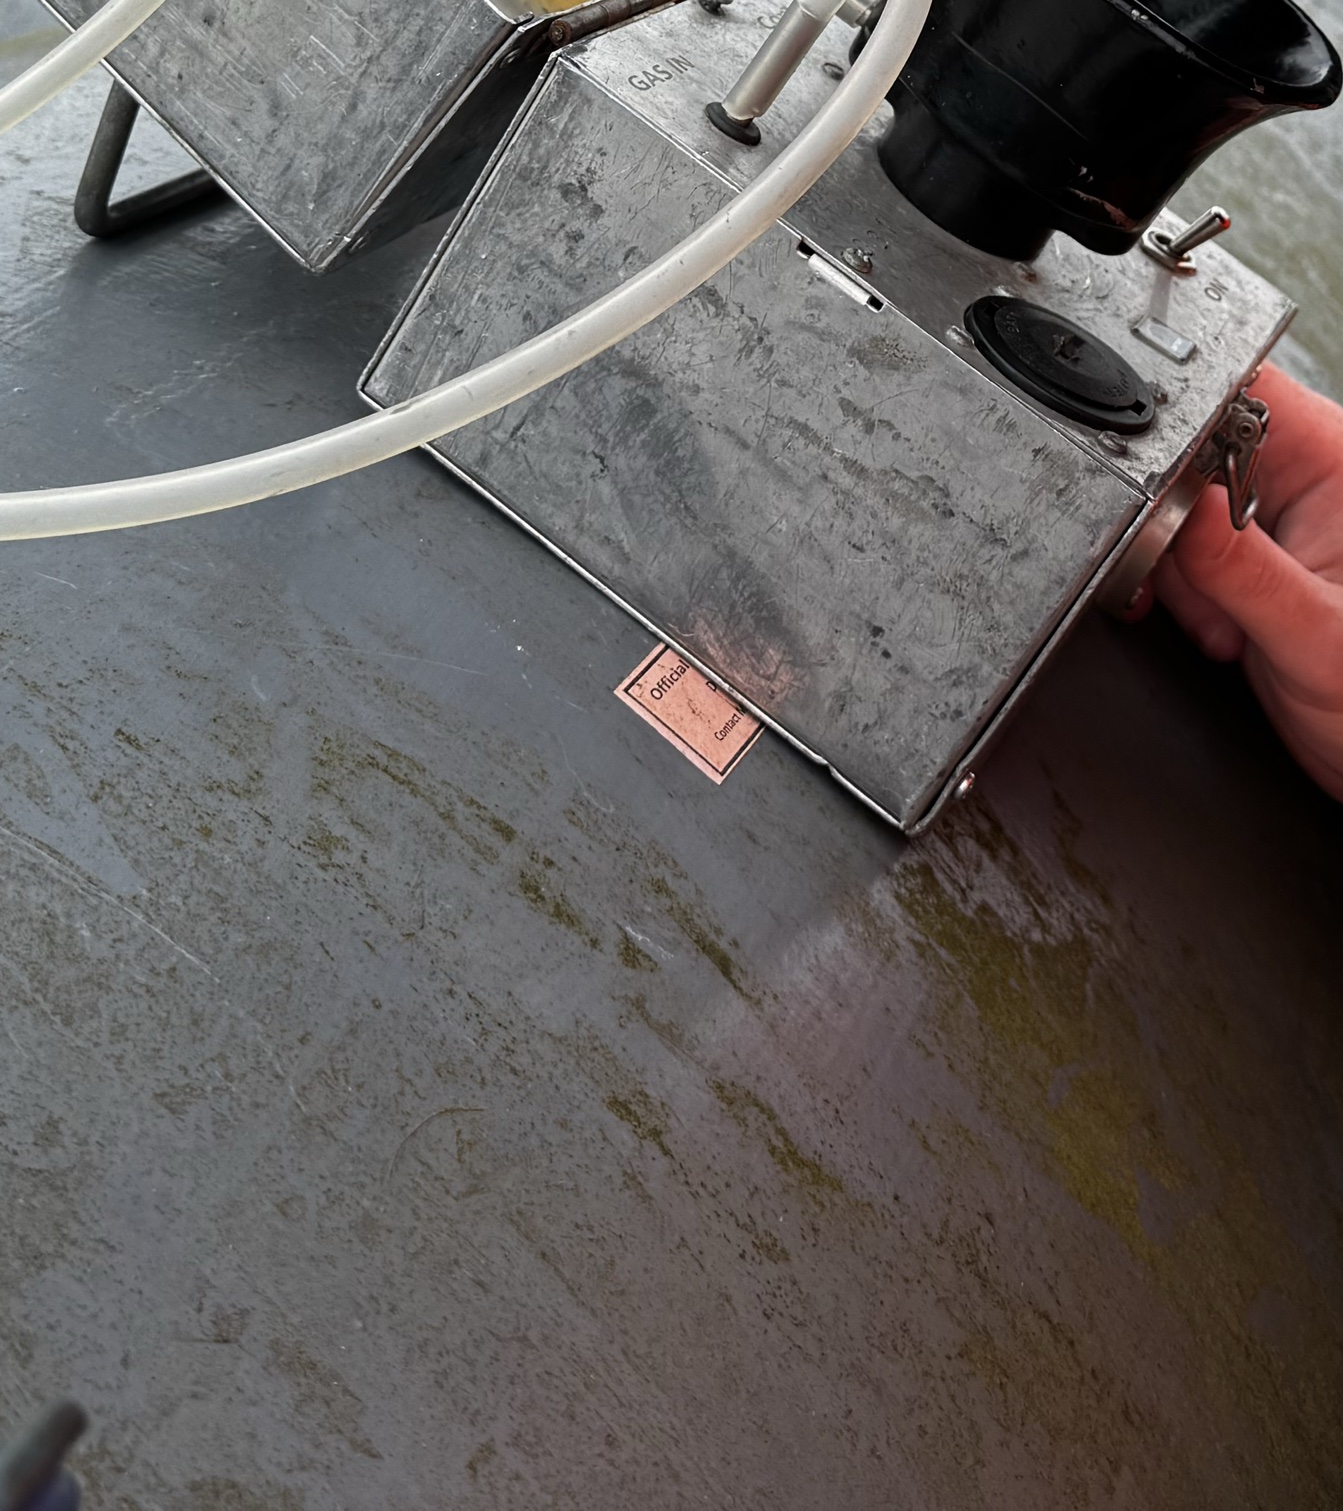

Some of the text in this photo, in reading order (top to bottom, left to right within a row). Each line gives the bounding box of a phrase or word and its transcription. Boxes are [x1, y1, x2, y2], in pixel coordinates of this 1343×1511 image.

[628, 55, 695, 91] GAS IN
[1204, 278, 1229, 302] ON
[650, 659, 690, 700] Official
[714, 713, 741, 741] Contact
